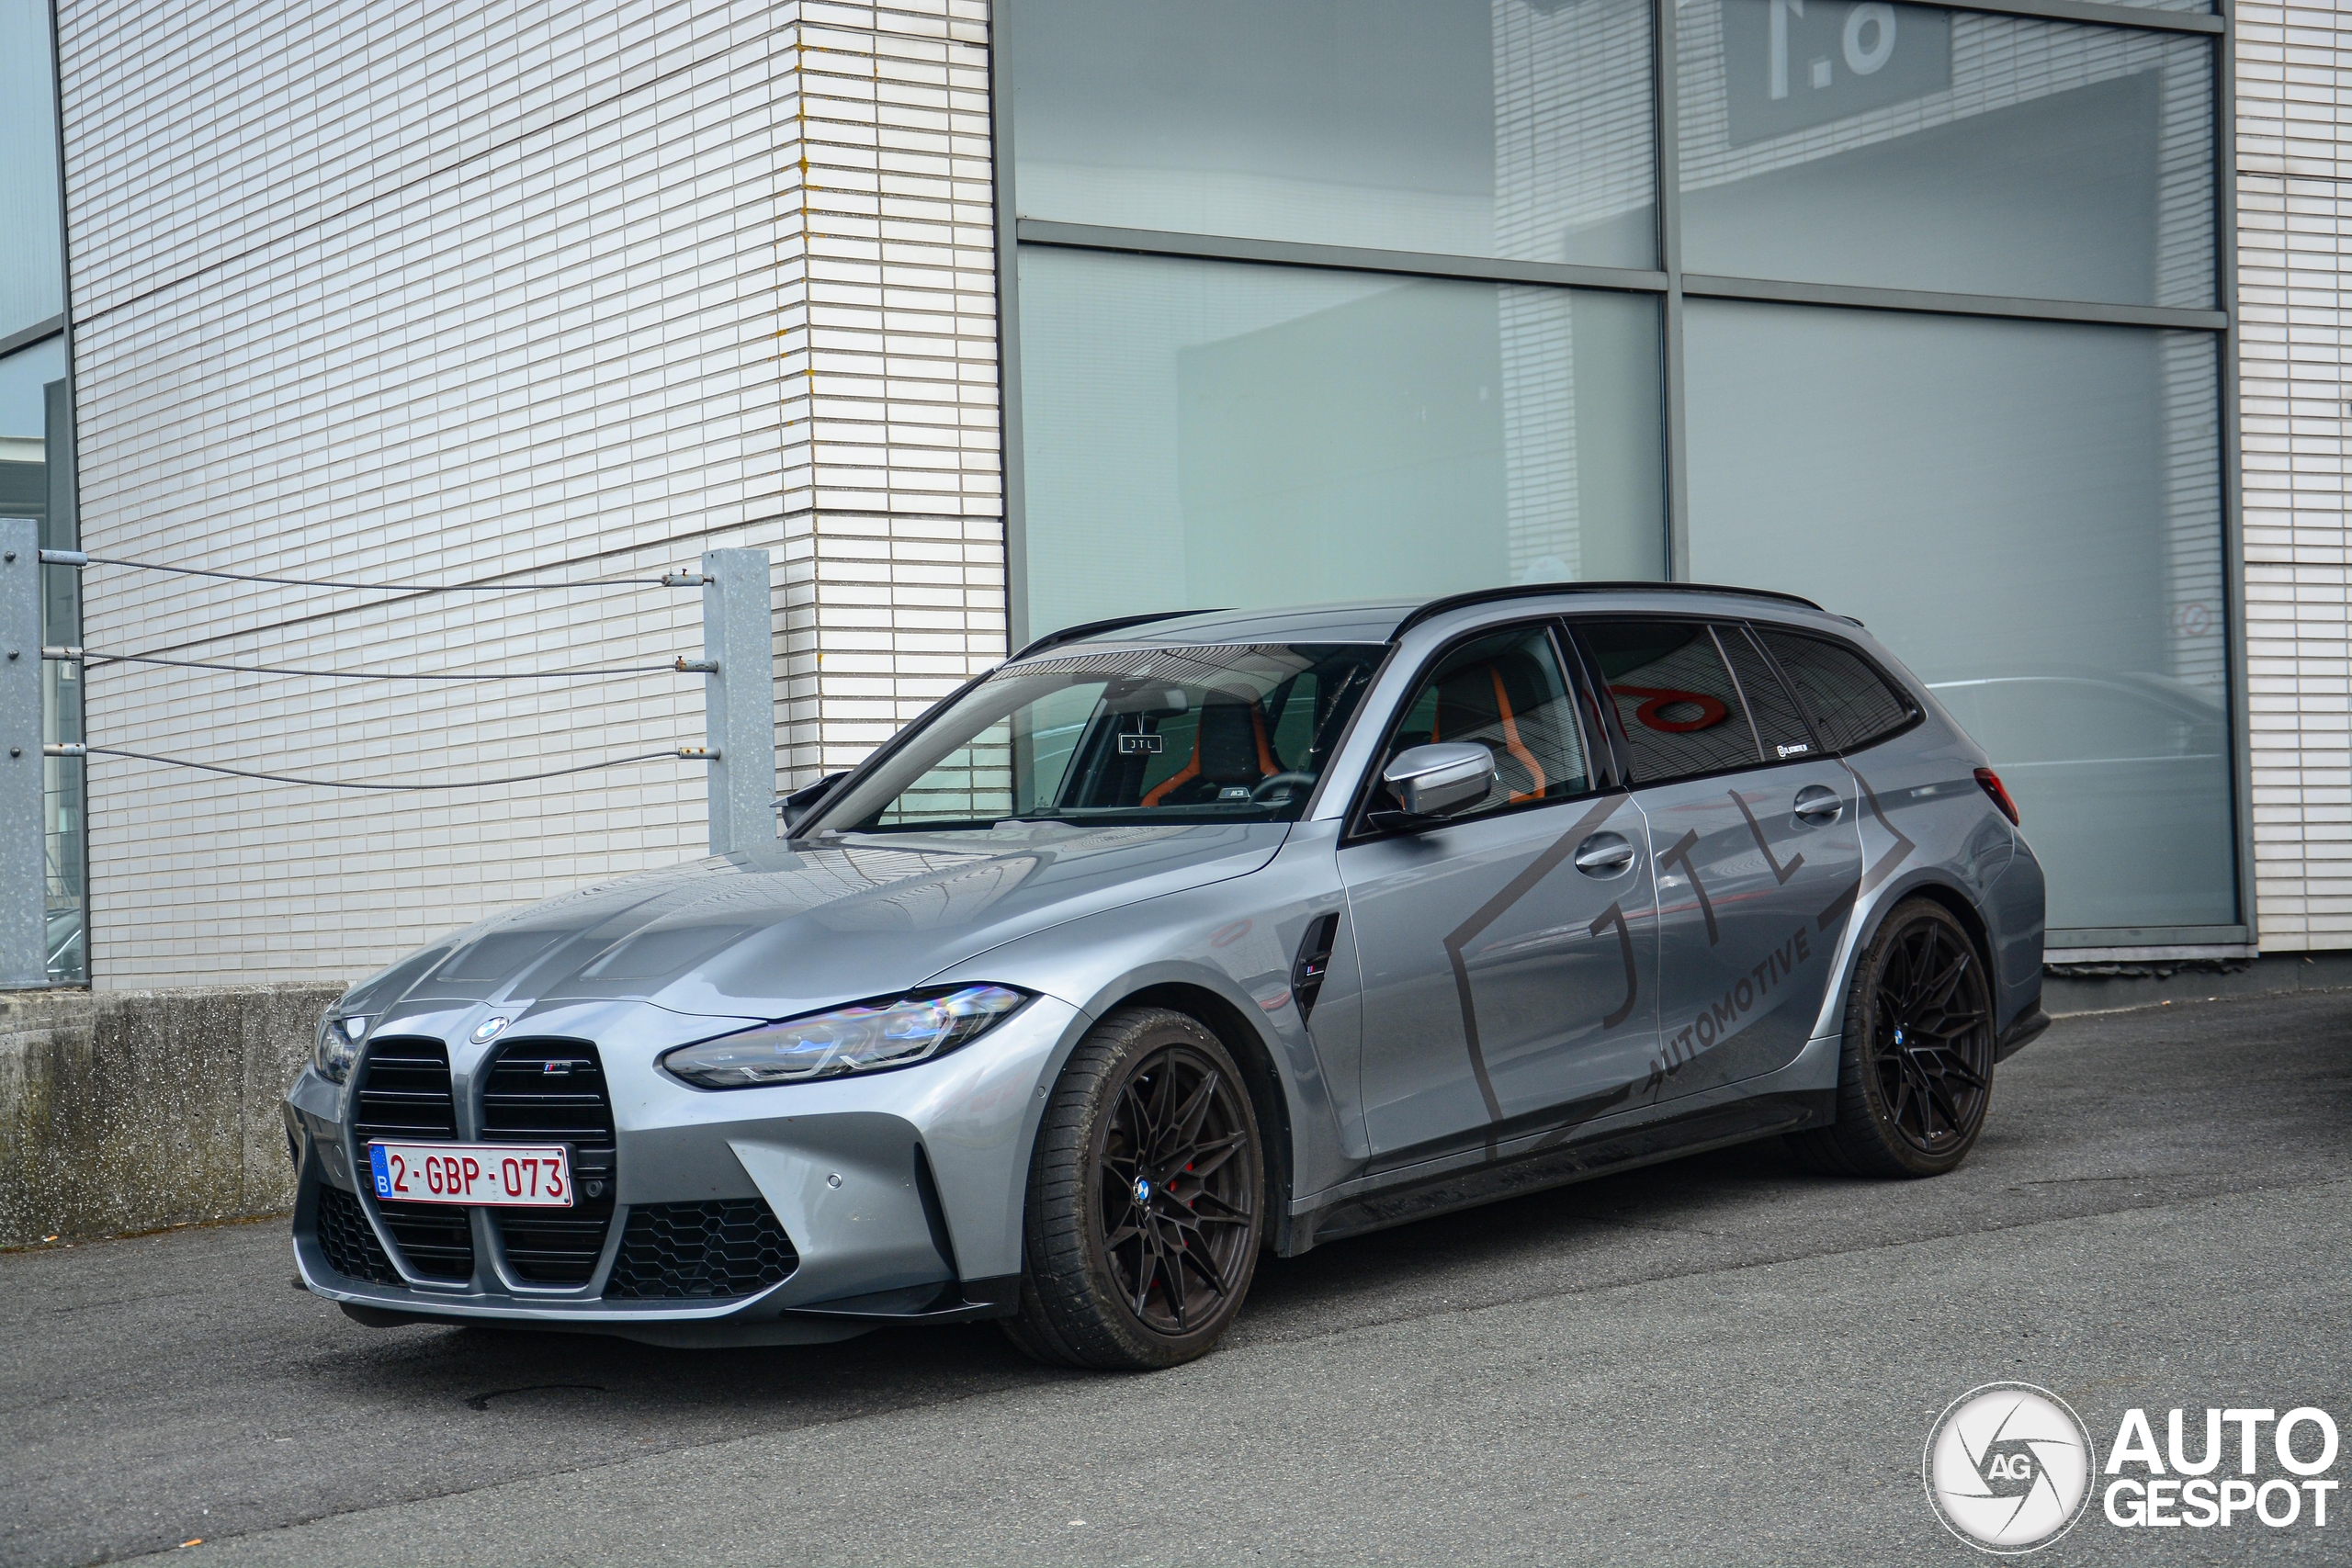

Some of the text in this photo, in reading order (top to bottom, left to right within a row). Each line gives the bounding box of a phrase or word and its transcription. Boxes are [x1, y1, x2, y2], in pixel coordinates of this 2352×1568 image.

[1131, 739, 1153, 749] JTL
[1643, 927, 1812, 1094] AUTOMOTIVE
[377, 1176, 389, 1194] B
